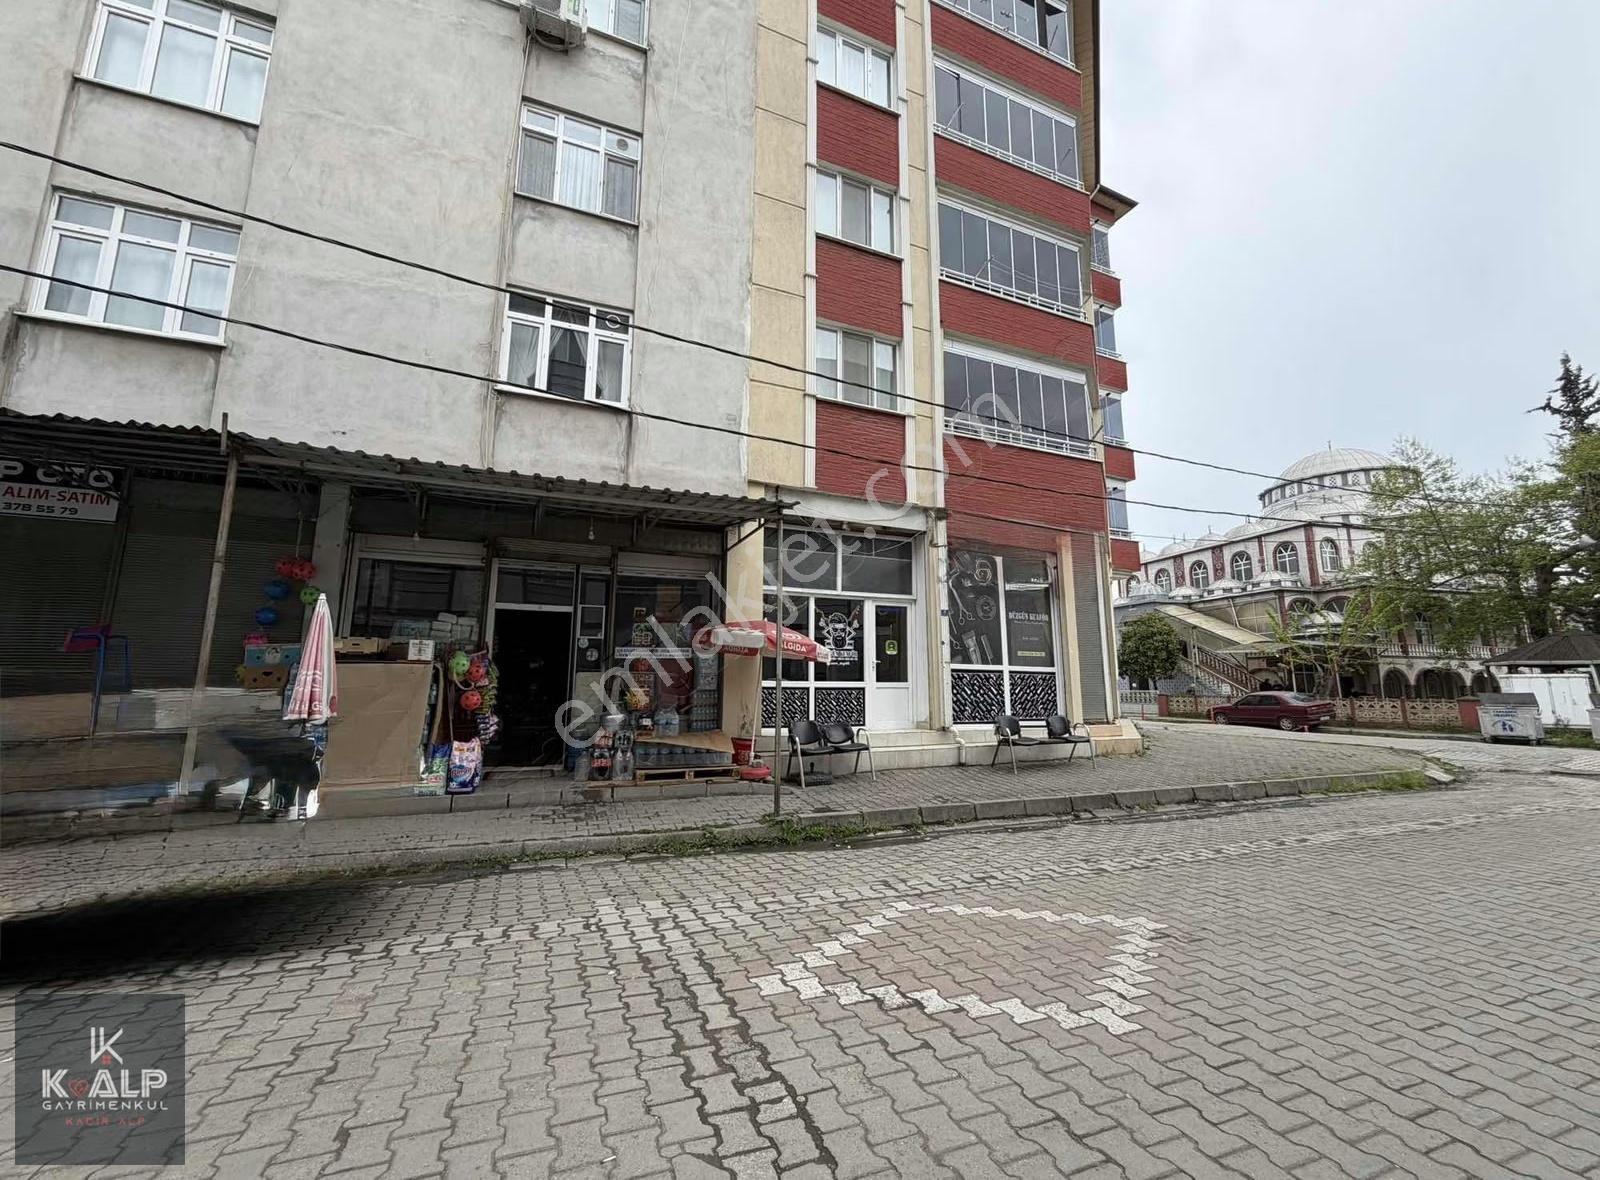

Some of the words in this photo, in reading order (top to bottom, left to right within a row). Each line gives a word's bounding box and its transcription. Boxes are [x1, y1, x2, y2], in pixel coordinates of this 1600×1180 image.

[2, 485, 111, 506] ALIM-SATIM
[2, 501, 32, 512] 378
[36, 504, 55, 514] 55
[60, 507, 78, 516] 79
